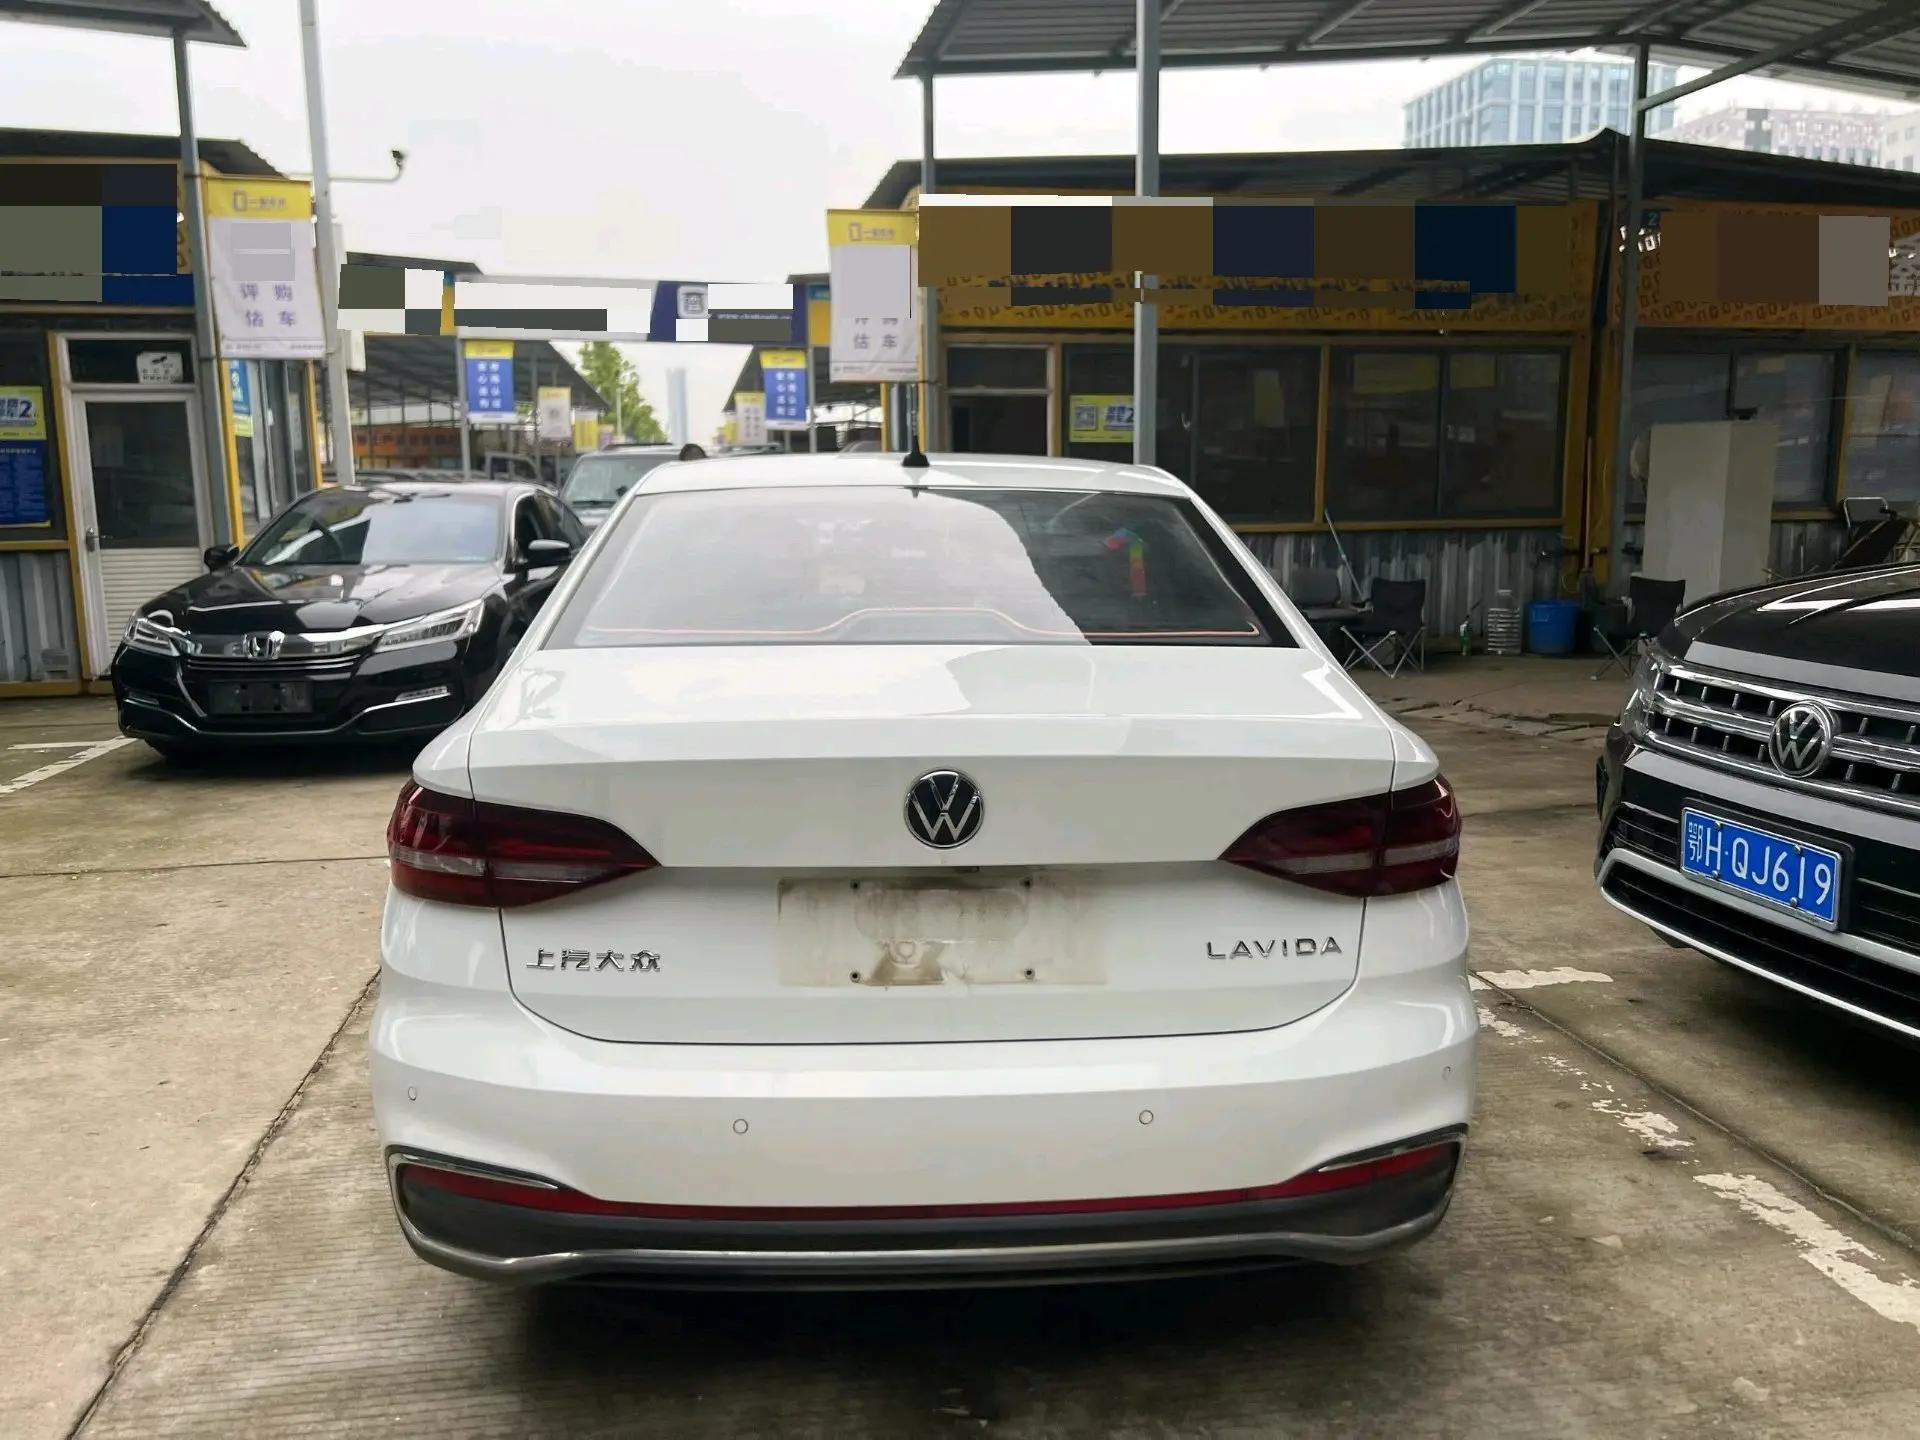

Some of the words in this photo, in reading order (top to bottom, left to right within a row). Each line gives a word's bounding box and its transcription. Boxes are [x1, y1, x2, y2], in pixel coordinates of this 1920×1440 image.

[1688, 821, 1832, 906] 鄂H·QJ619
[526, 948, 661, 972] 上汽大众
[1206, 936, 1343, 960] LAVIDA
